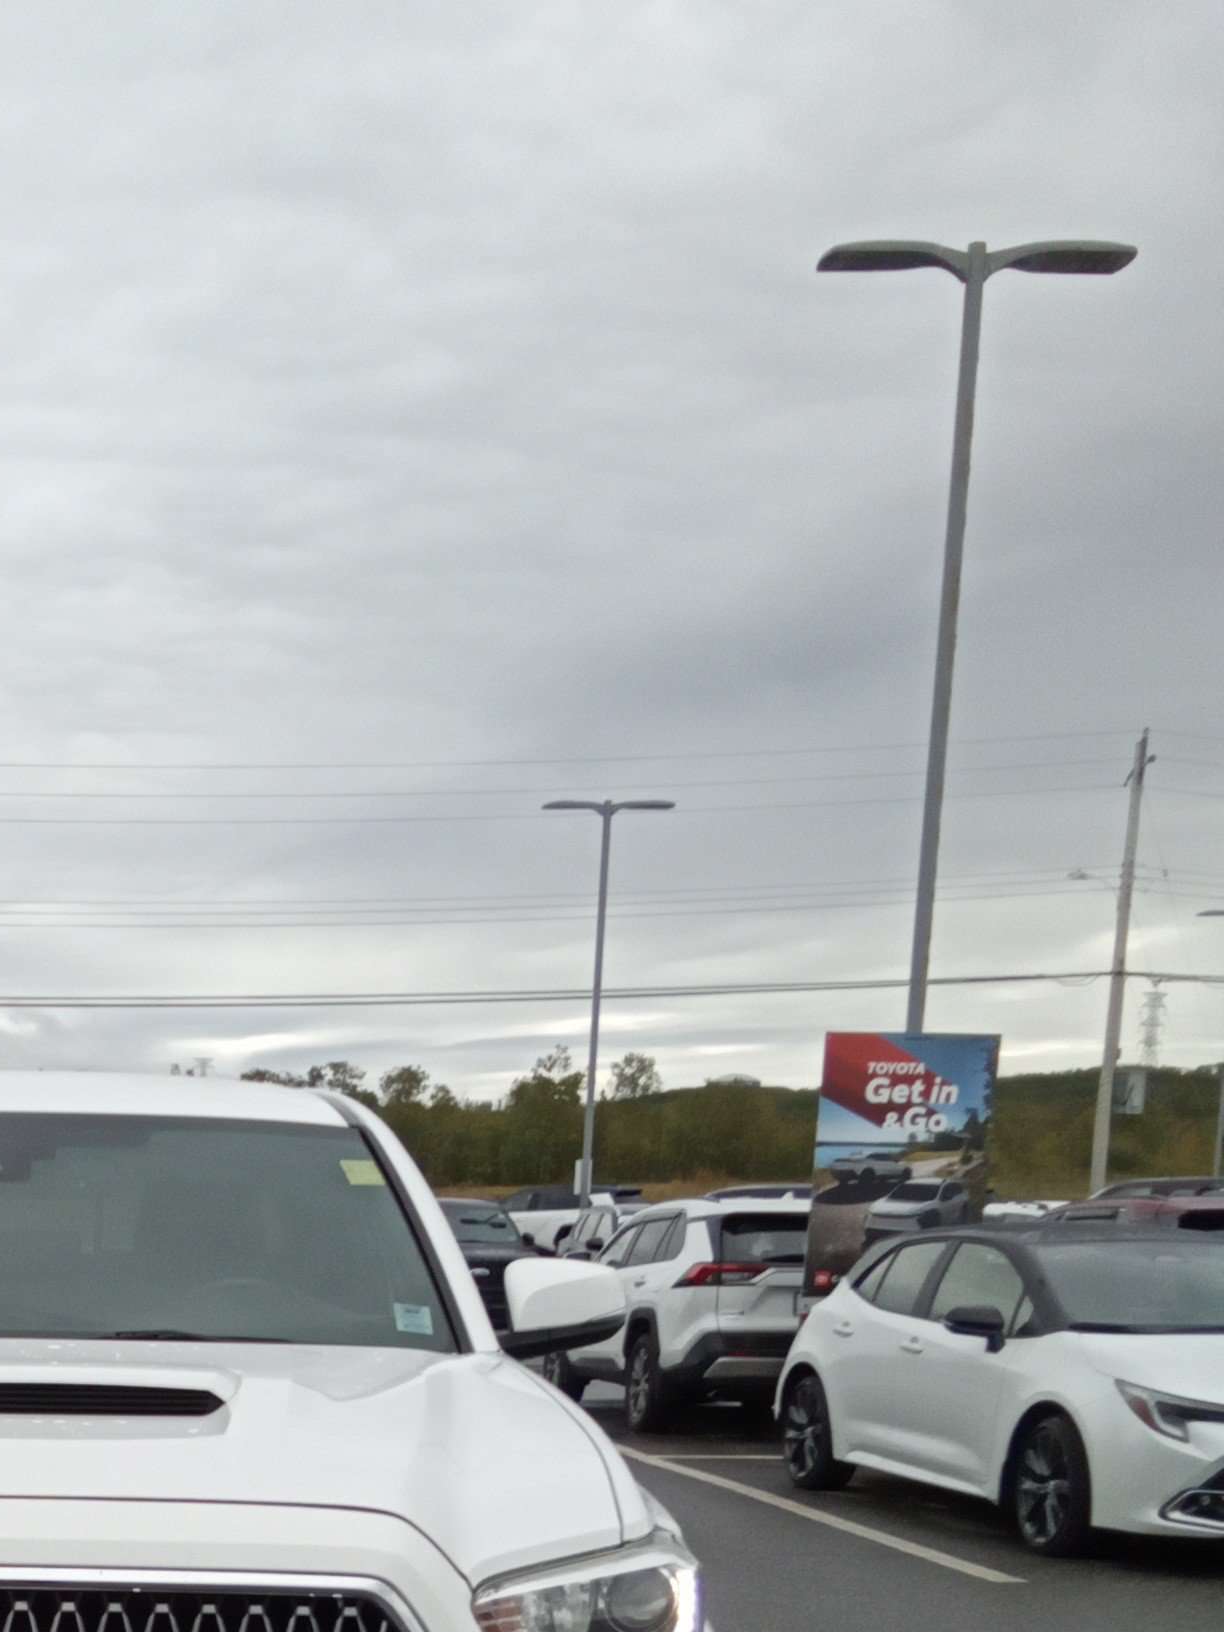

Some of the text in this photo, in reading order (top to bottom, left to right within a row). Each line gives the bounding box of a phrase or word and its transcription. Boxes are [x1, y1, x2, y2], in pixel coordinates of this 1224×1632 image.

[867, 1061, 925, 1075] TOYOTA
[864, 1076, 959, 1105] Get in
